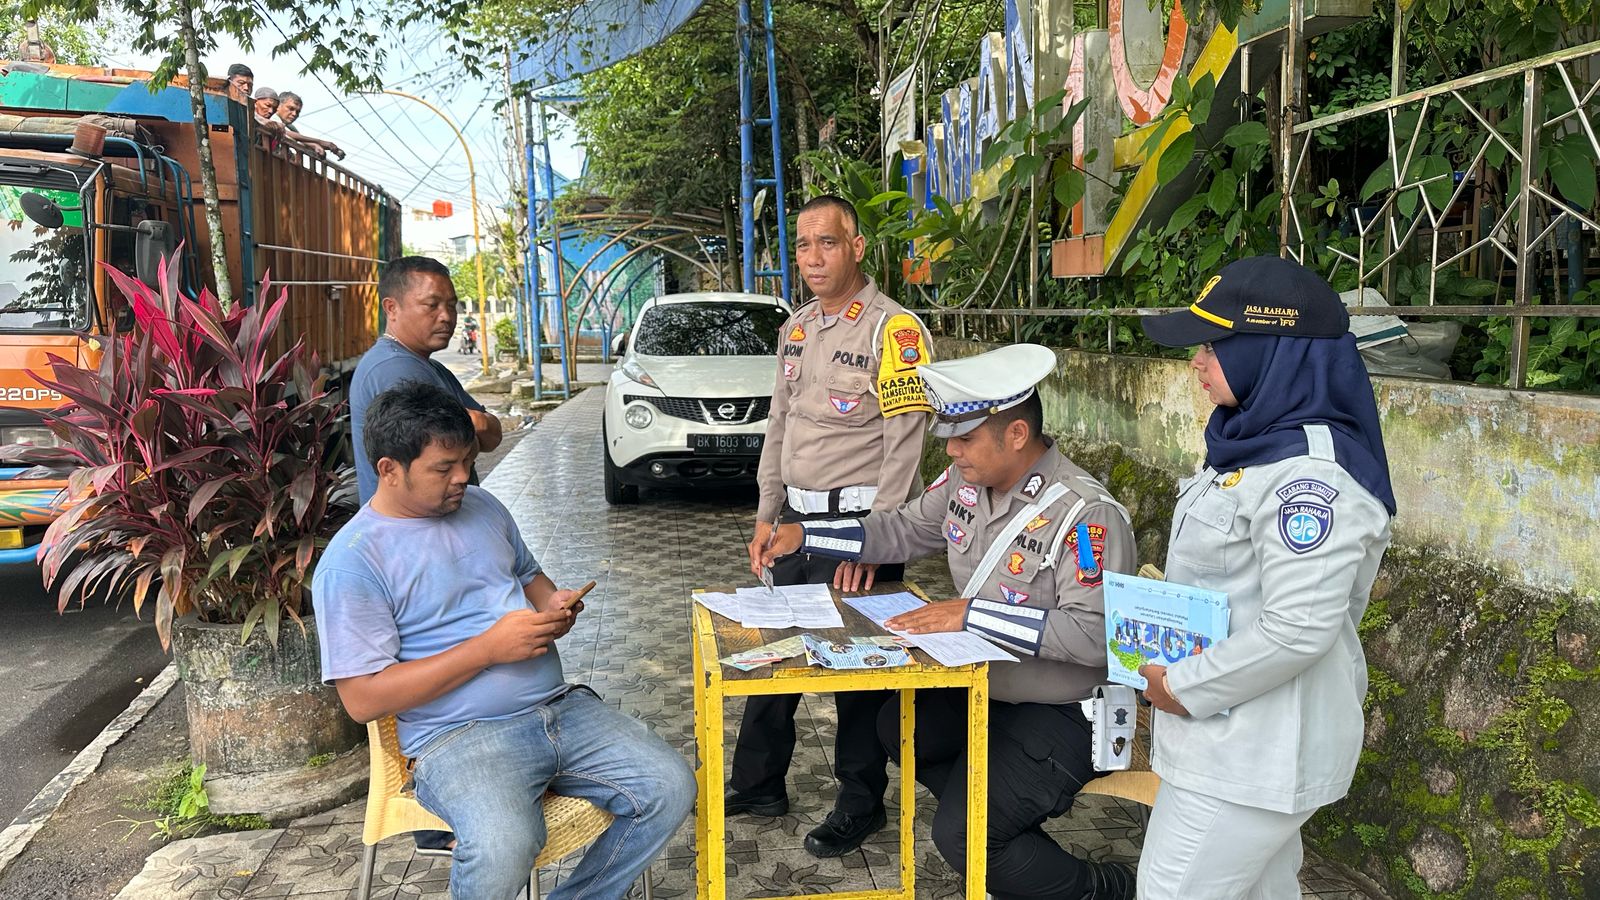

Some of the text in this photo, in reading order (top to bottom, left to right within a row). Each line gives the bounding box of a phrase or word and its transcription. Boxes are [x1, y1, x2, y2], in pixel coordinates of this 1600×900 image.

[1244, 305, 1299, 317] JASA RAHARJA
[832, 350, 870, 369] POLRI
[697, 436, 710, 448] BK
[716, 436, 739, 448] 1603
[1282, 483, 1334, 499] CABANG SUMUT
[949, 499, 975, 525] RIKY
[1284, 506, 1329, 520] JASA RAHARJA
